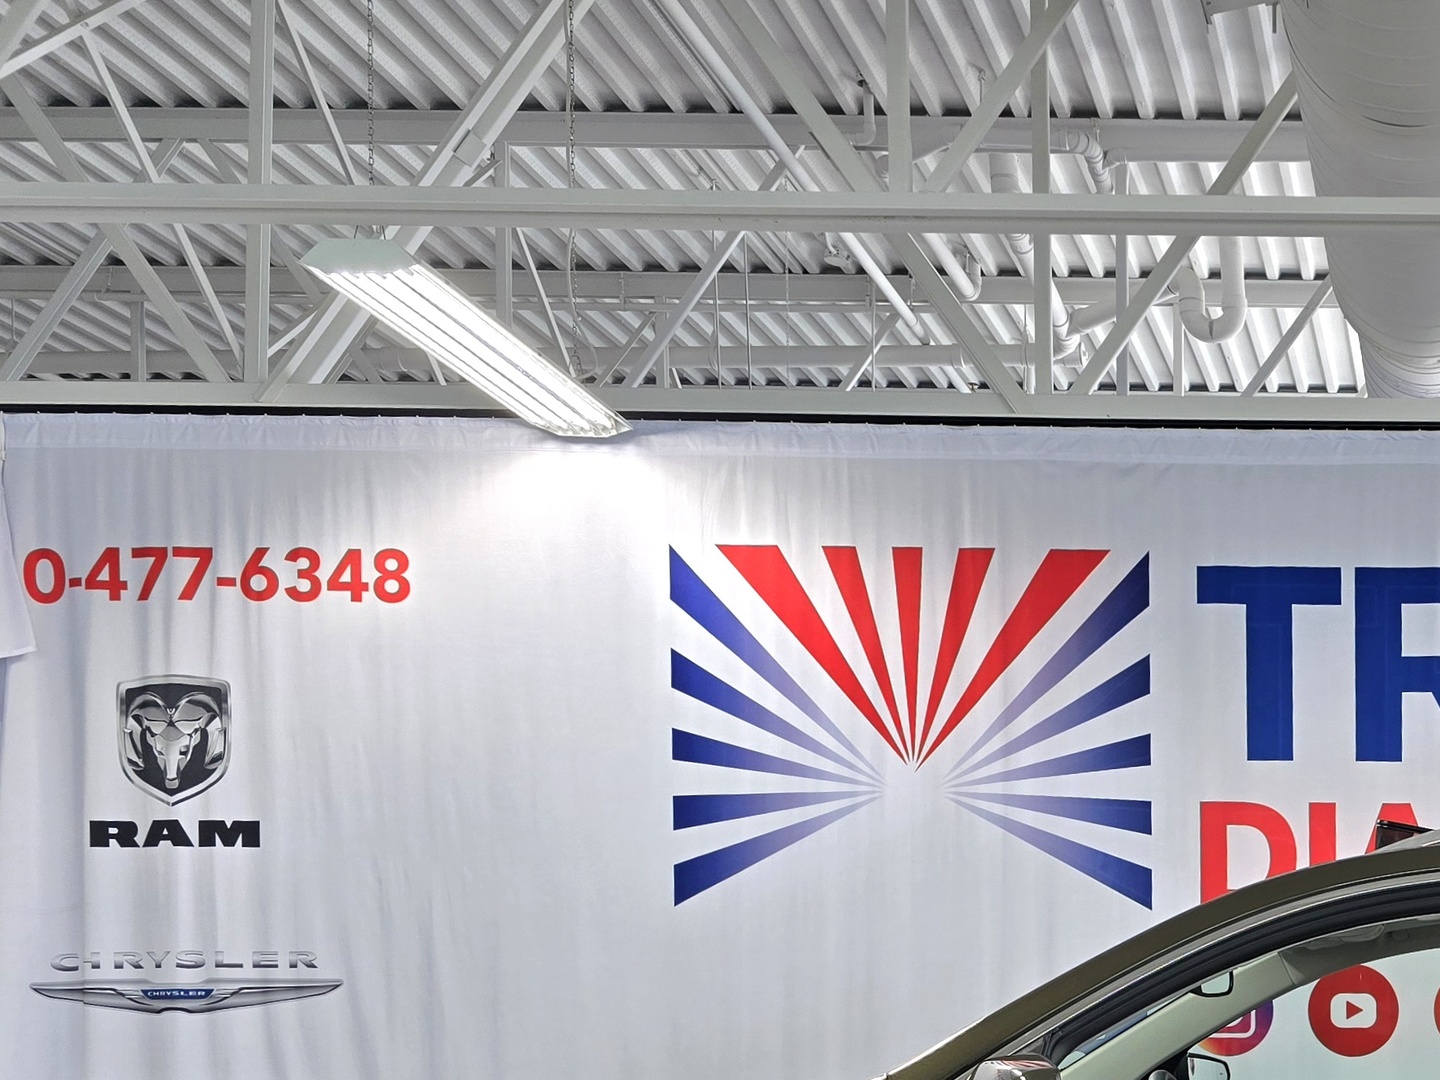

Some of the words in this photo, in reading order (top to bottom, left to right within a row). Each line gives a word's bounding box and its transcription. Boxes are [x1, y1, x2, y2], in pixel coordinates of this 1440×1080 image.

[22, 547, 411, 604] 0-477-6348
[89, 819, 261, 848] RAM
[50, 950, 319, 972] CHRYSLER
